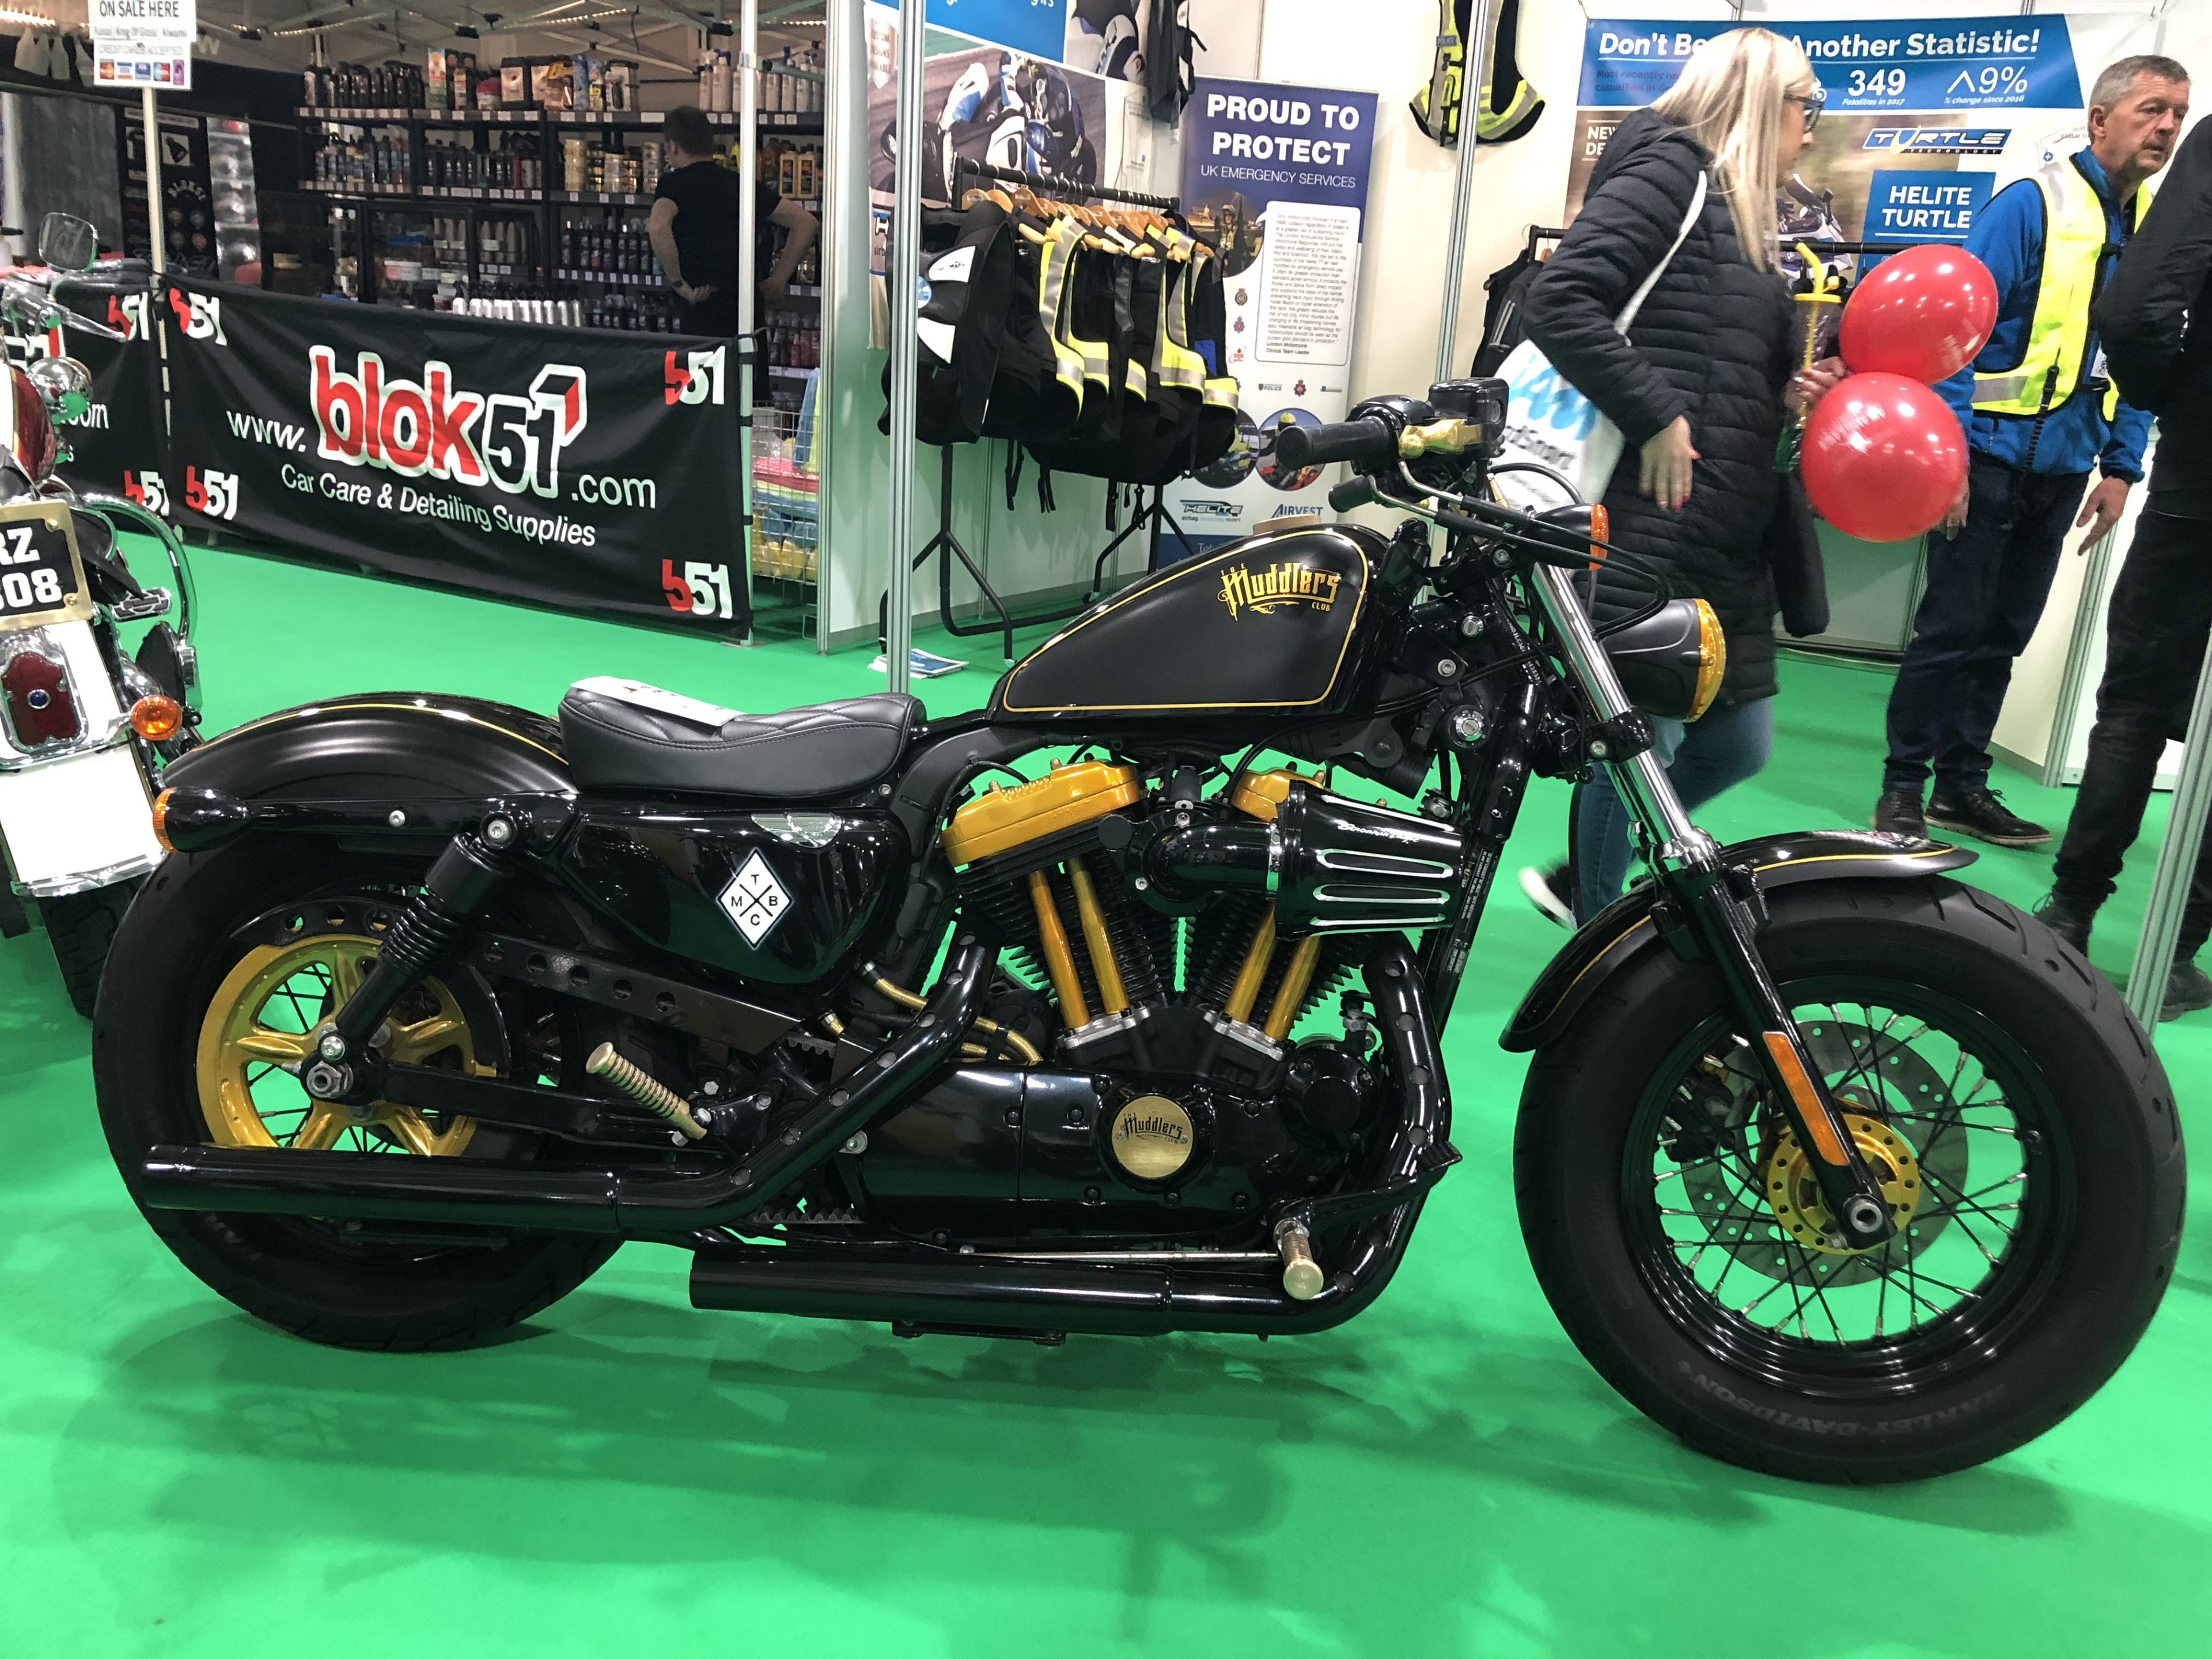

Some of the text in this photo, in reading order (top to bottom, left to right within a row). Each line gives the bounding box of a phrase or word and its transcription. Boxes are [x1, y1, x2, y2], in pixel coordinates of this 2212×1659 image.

[99, 1, 179, 17] ON SALE HERE
[1599, 33, 1668, 55] Don't
[1906, 28, 2040, 55] Statistic!
[1597, 70, 1618, 78] Most
[1622, 71, 1664, 80] recently
[1848, 69, 1906, 96] 349
[1207, 93, 1359, 130] PROUD TO
[1212, 131, 1350, 165] PROTECT
[1873, 128, 2006, 150] TURTLE
[1201, 165, 1356, 188] UK EMERGENCY SERVICES
[1889, 185, 1972, 206] HELITE
[1882, 209, 1972, 229] TURTLE
[664, 346, 725, 405] b51
[226, 411, 306, 452] www.
[571, 474, 656, 509] .com
[185, 465, 238, 520] b51
[281, 464, 596, 547] Car Care & Detailing Supplies
[1184, 504, 1244, 516] HELITE
[1271, 504, 1323, 518] AIRVEST
[662, 559, 733, 619] b51
[1217, 563, 1342, 621] Muddlers
[1312, 602, 1331, 612] CLUB
[751, 874, 759, 885] T
[731, 896, 778, 907] M B
[751, 914, 760, 926] C
[1121, 1116, 1183, 1140] Muddlers
